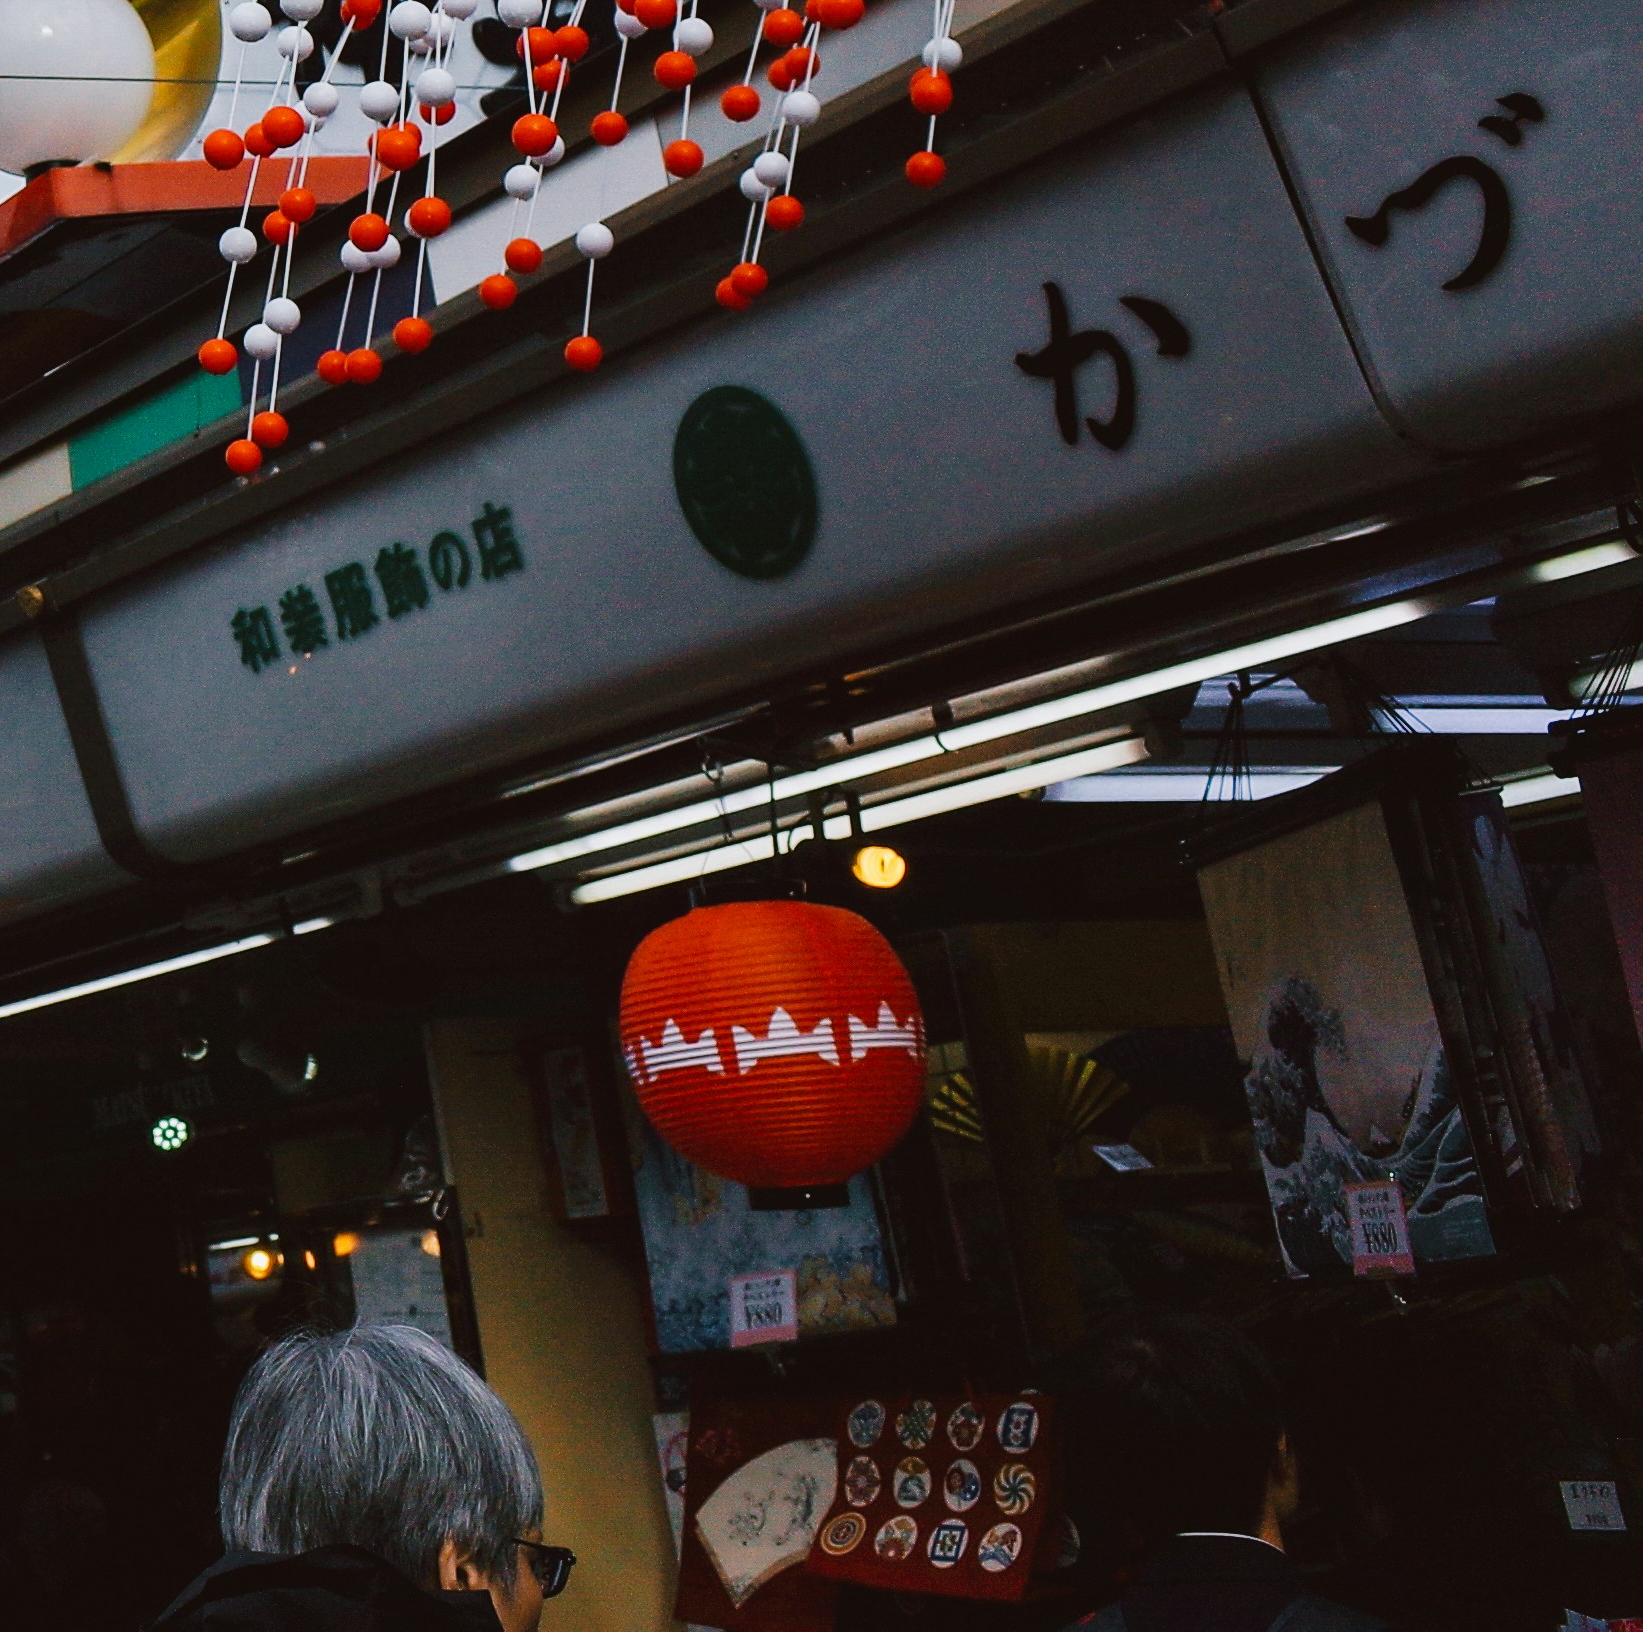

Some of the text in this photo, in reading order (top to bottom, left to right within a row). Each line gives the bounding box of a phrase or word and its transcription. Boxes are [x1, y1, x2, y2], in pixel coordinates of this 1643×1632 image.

[1015, 91, 1547, 452] かづ
[230, 500, 525, 675] 和装服飾の店
[1362, 1222, 1398, 1254] ¥880
